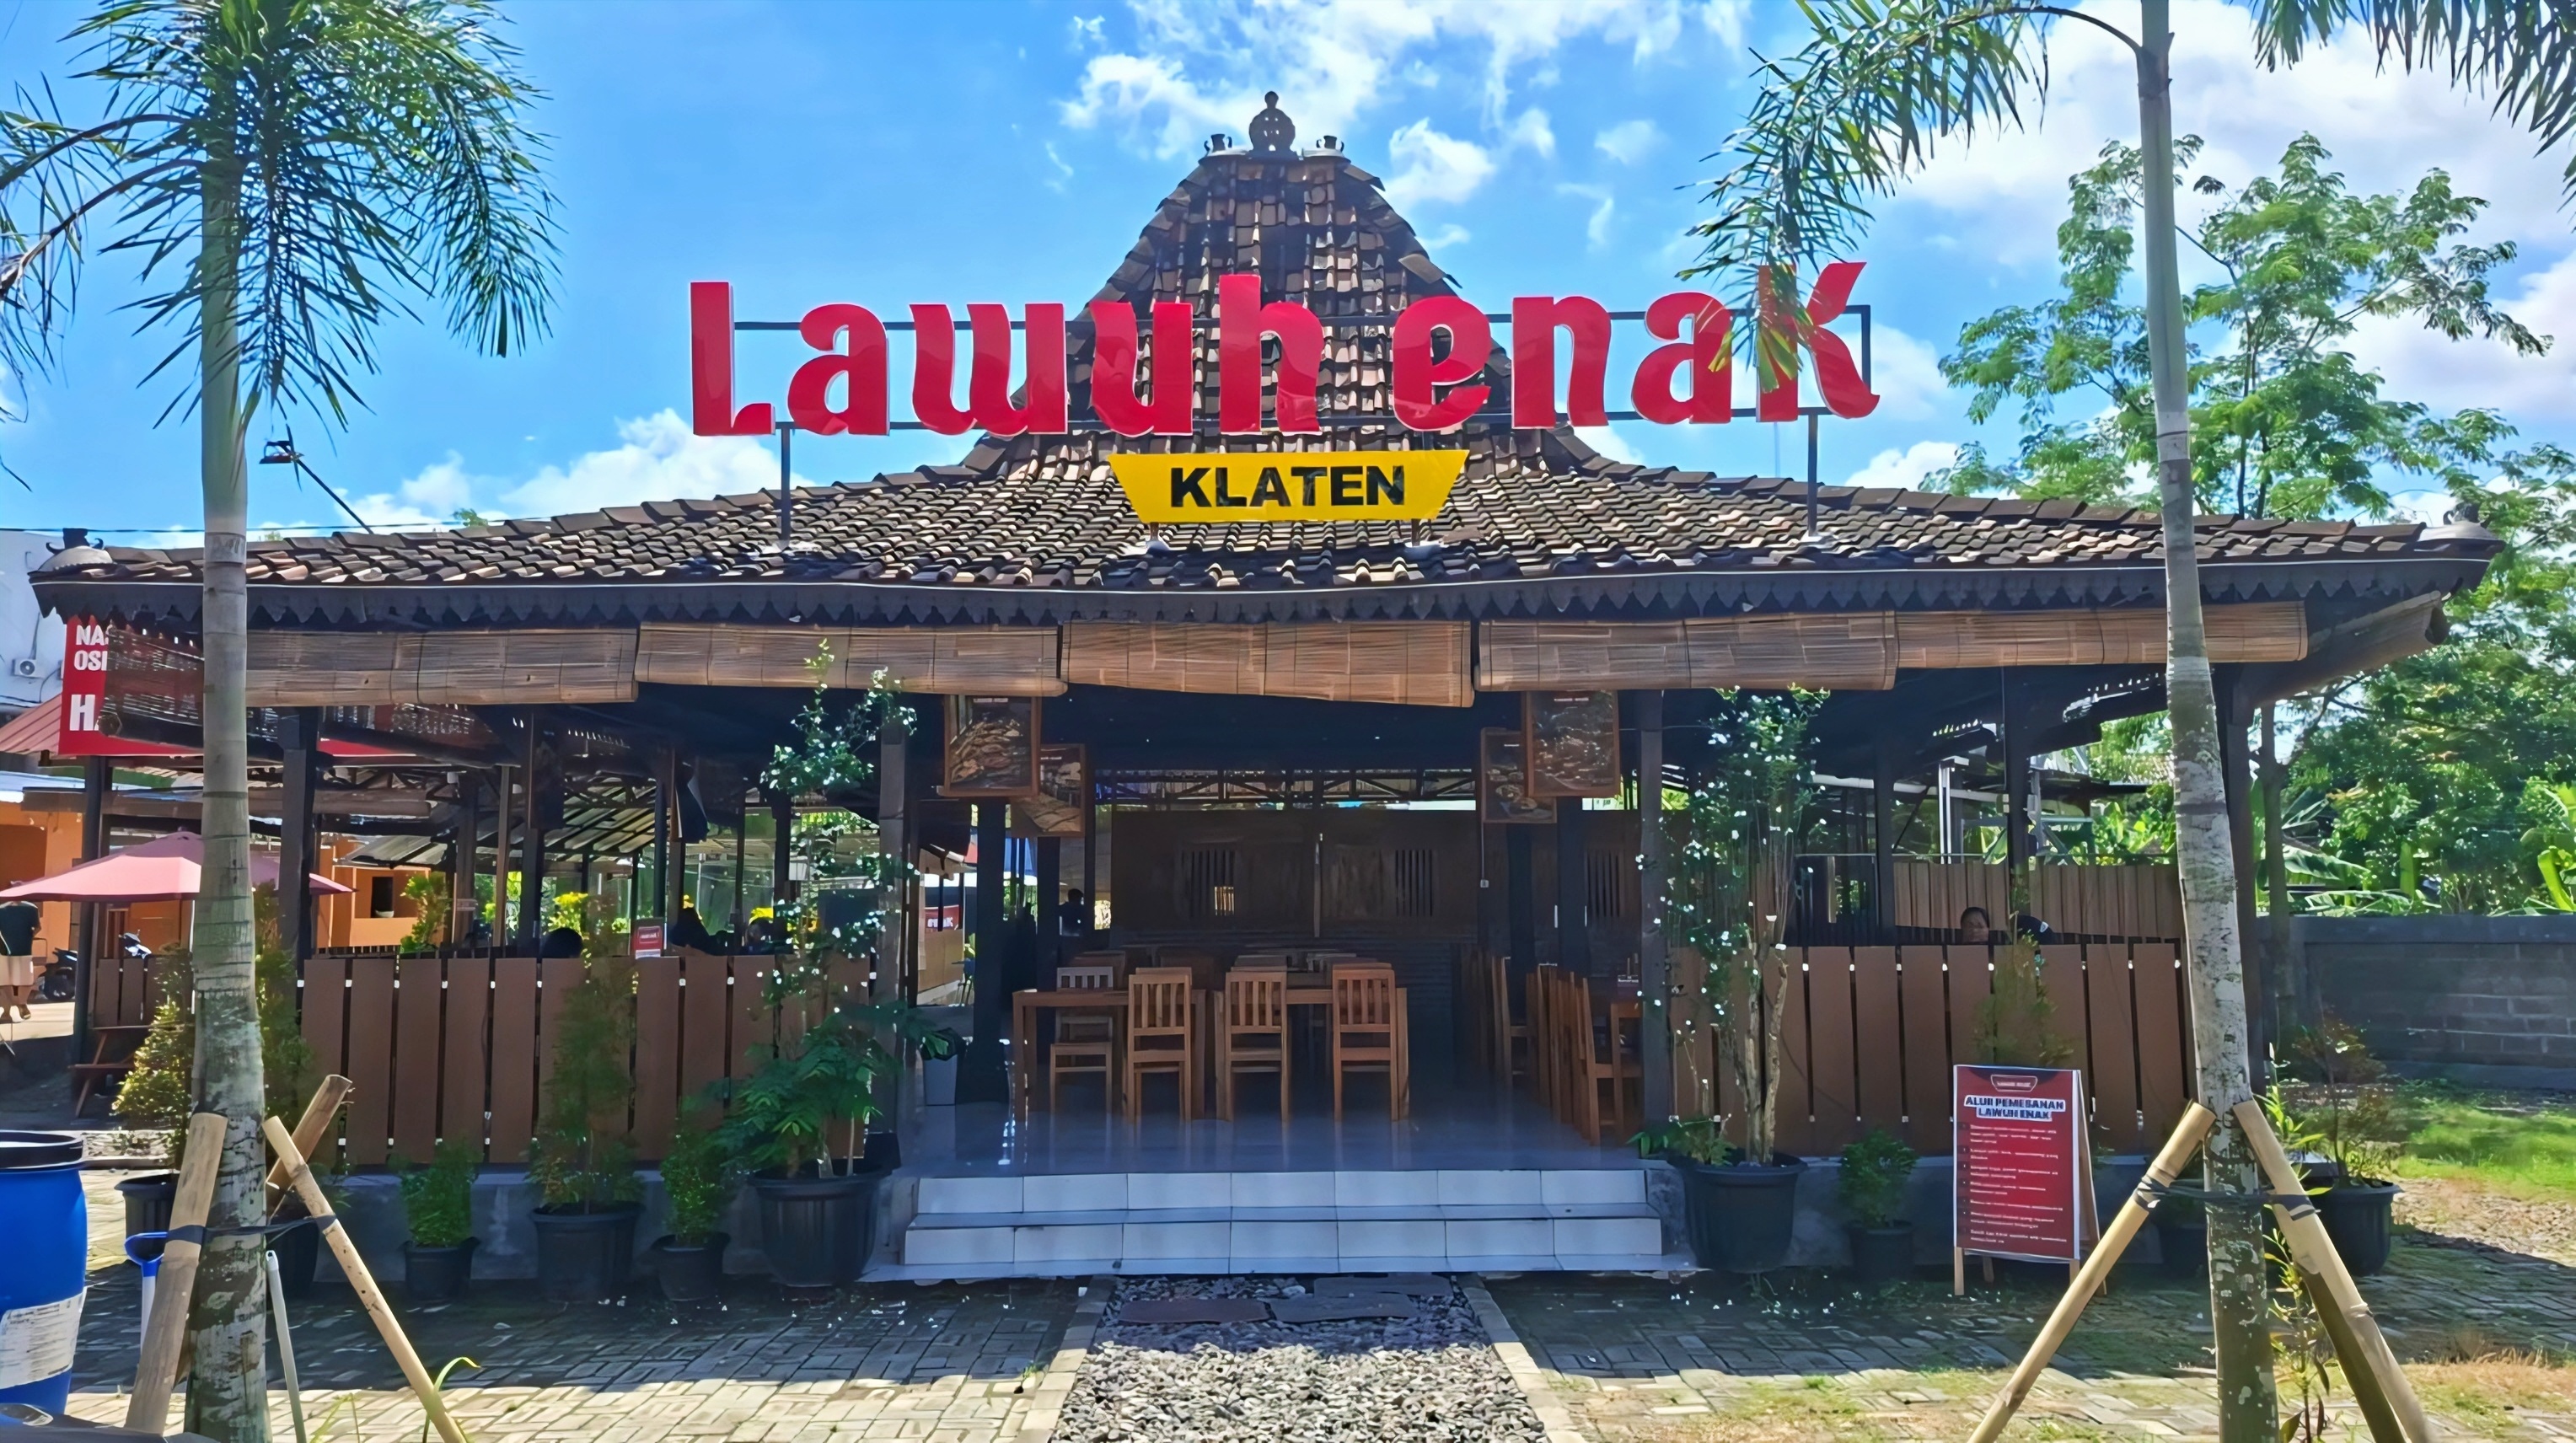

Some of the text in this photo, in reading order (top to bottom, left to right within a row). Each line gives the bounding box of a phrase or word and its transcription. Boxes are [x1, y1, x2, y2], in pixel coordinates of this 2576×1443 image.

[690, 274, 1323, 437] Lawuh
[1171, 465, 1405, 507] KLATEN
[75, 625, 109, 646] NA
[2020, 1111, 2050, 1119] ENAK
